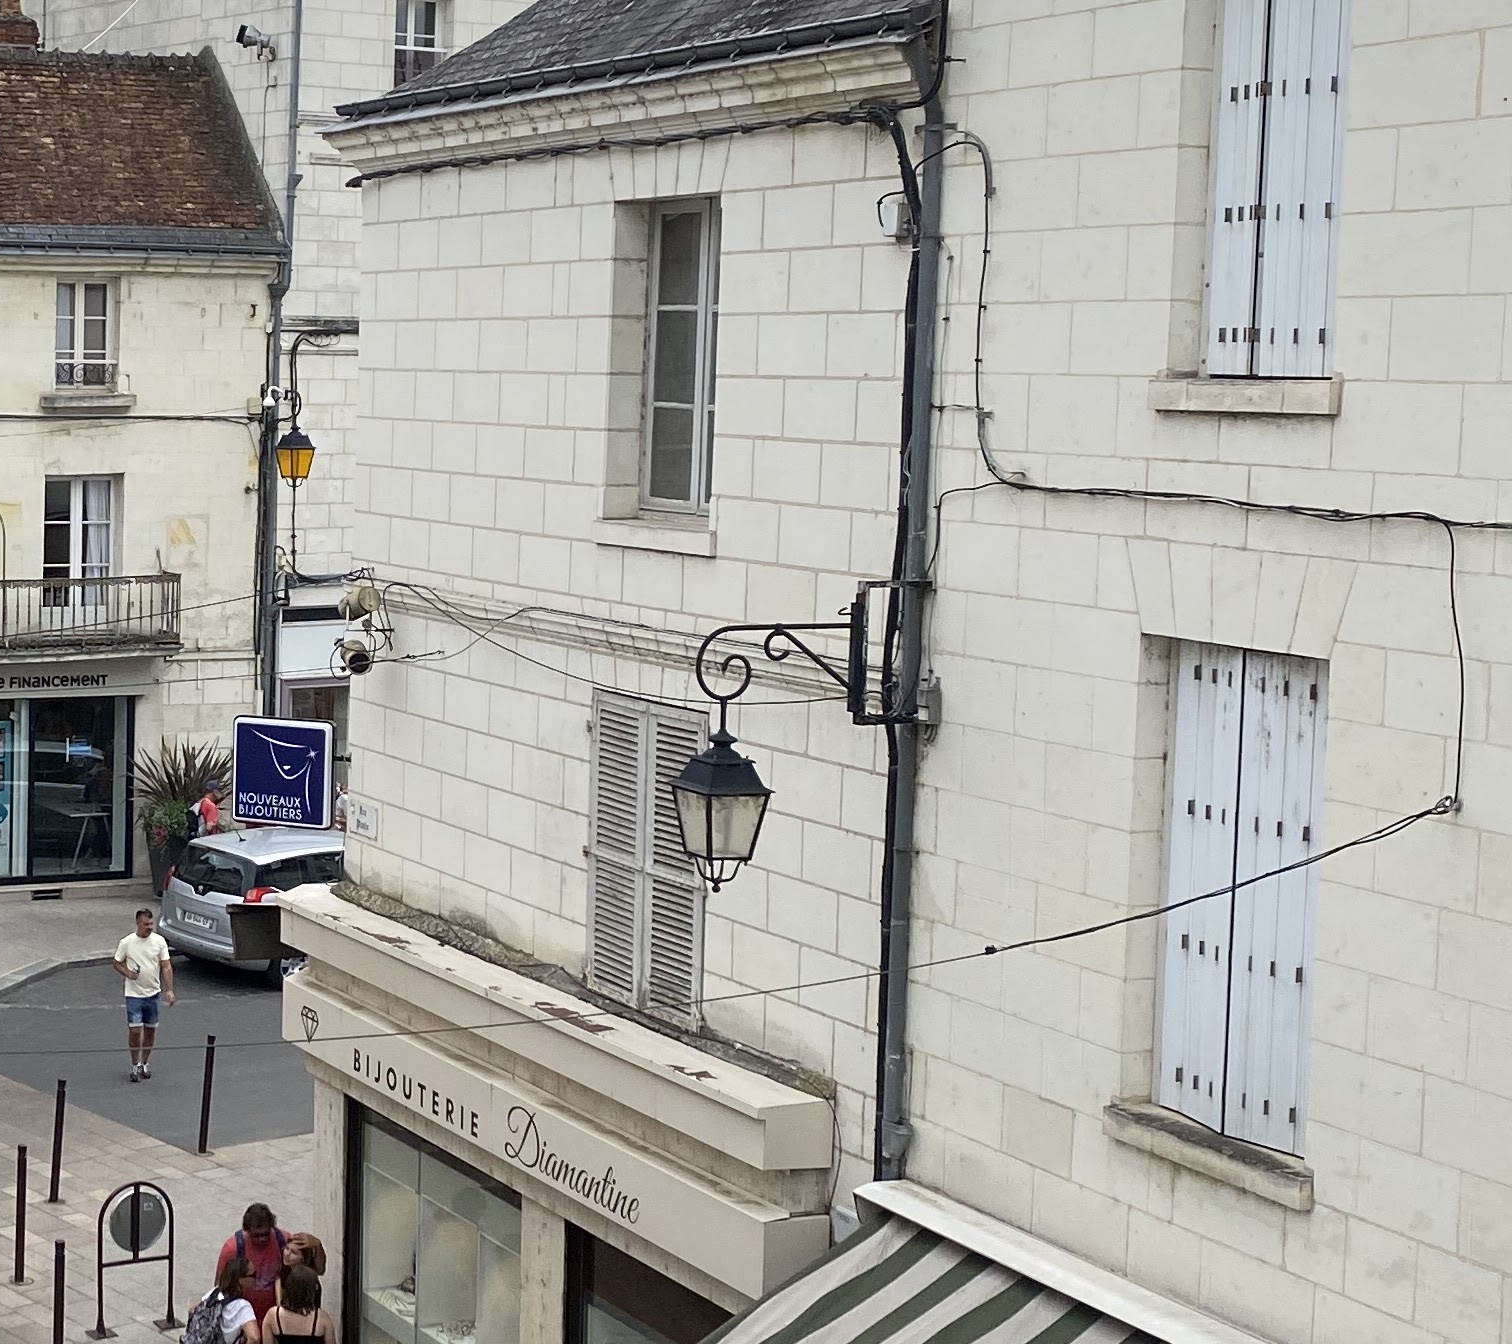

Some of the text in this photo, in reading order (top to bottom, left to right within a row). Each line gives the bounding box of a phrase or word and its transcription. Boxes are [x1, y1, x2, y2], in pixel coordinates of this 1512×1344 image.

[239, 792, 301, 808] NOUVEAUX
[238, 804, 302, 820] BIJOUTIERS
[353, 1047, 641, 1224] BIJOUTERIE Diamantine
